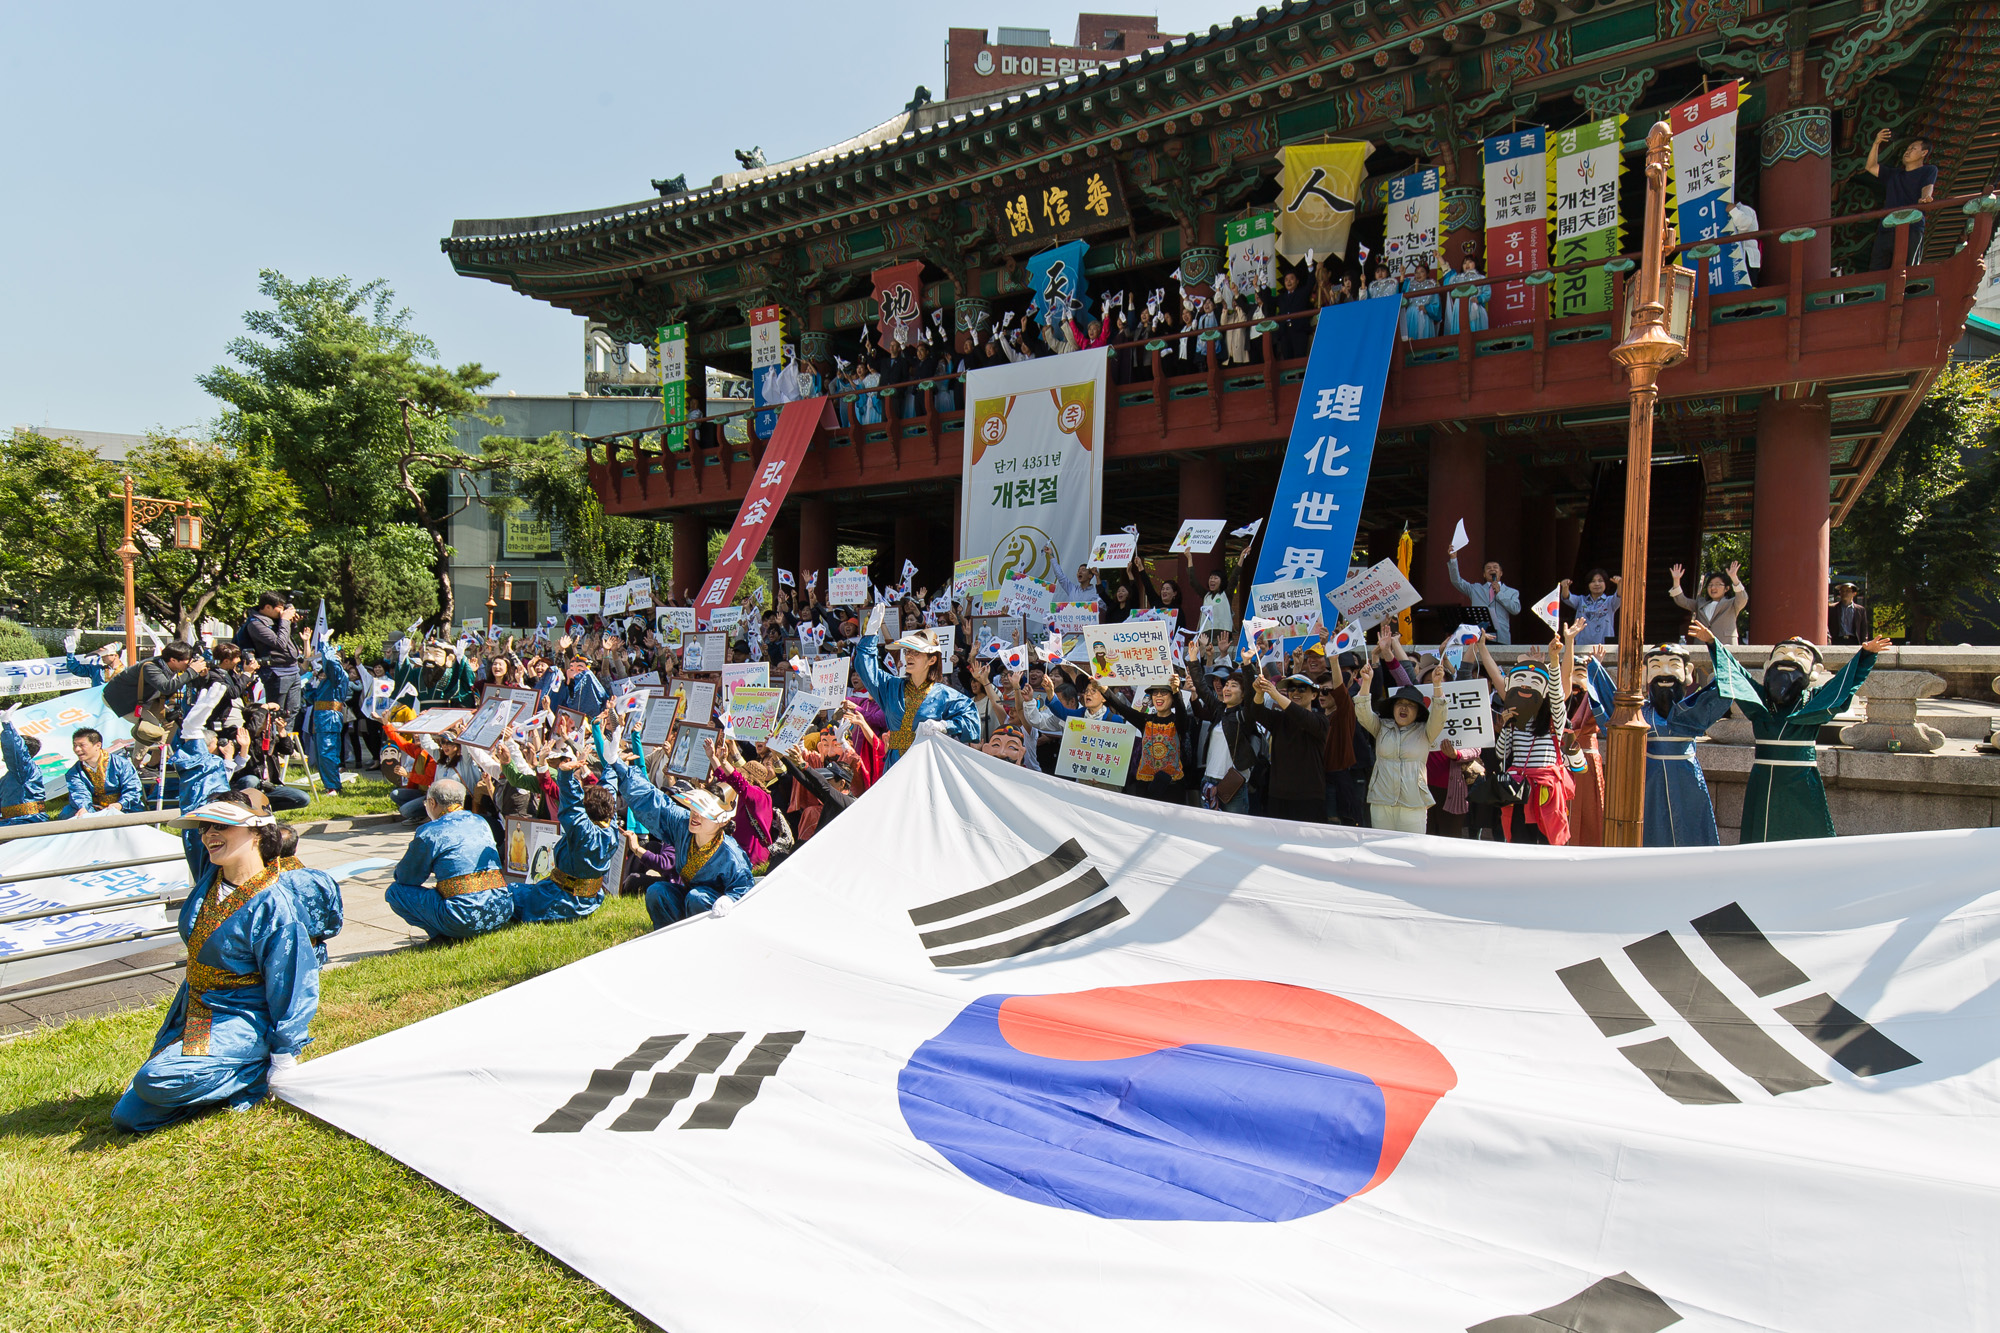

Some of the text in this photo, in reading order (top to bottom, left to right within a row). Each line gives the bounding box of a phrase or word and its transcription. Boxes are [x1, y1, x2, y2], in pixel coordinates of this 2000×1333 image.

[1001, 55, 1108, 76] 마이크임
[1287, 166, 1356, 213] 人
[1495, 191, 1536, 207] 개천절
[1558, 181, 1616, 210] 개천절
[1558, 205, 1617, 236] 開天節
[1562, 236, 1588, 317] KORE
[1043, 260, 1084, 319] 天
[880, 284, 920, 326] 地
[994, 451, 1062, 474] 단기 4351년
[991, 475, 1059, 509] 개천절
[1274, 383, 1364, 582] 理化世界
[1015, 592, 1038, 605] 인간사랑
[1259, 587, 1313, 602] 4350번째 대한민국
[1347, 581, 1401, 615] 4350번째 생일을
[1353, 580, 1383, 598] 대한민국
[1261, 598, 1315, 612] 생일을 축하합니다!
[1113, 631, 1163, 643] 4350번째
[820, 672, 839, 684] 개천절은
[1116, 663, 1171, 678] 축하합니다.
[1443, 716, 1482, 736] 홍익
[1080, 735, 1119, 749] 보신각에서
[1068, 748, 1121, 766] 개천절 타종식
[1071, 762, 1111, 778] 함께 해요!
